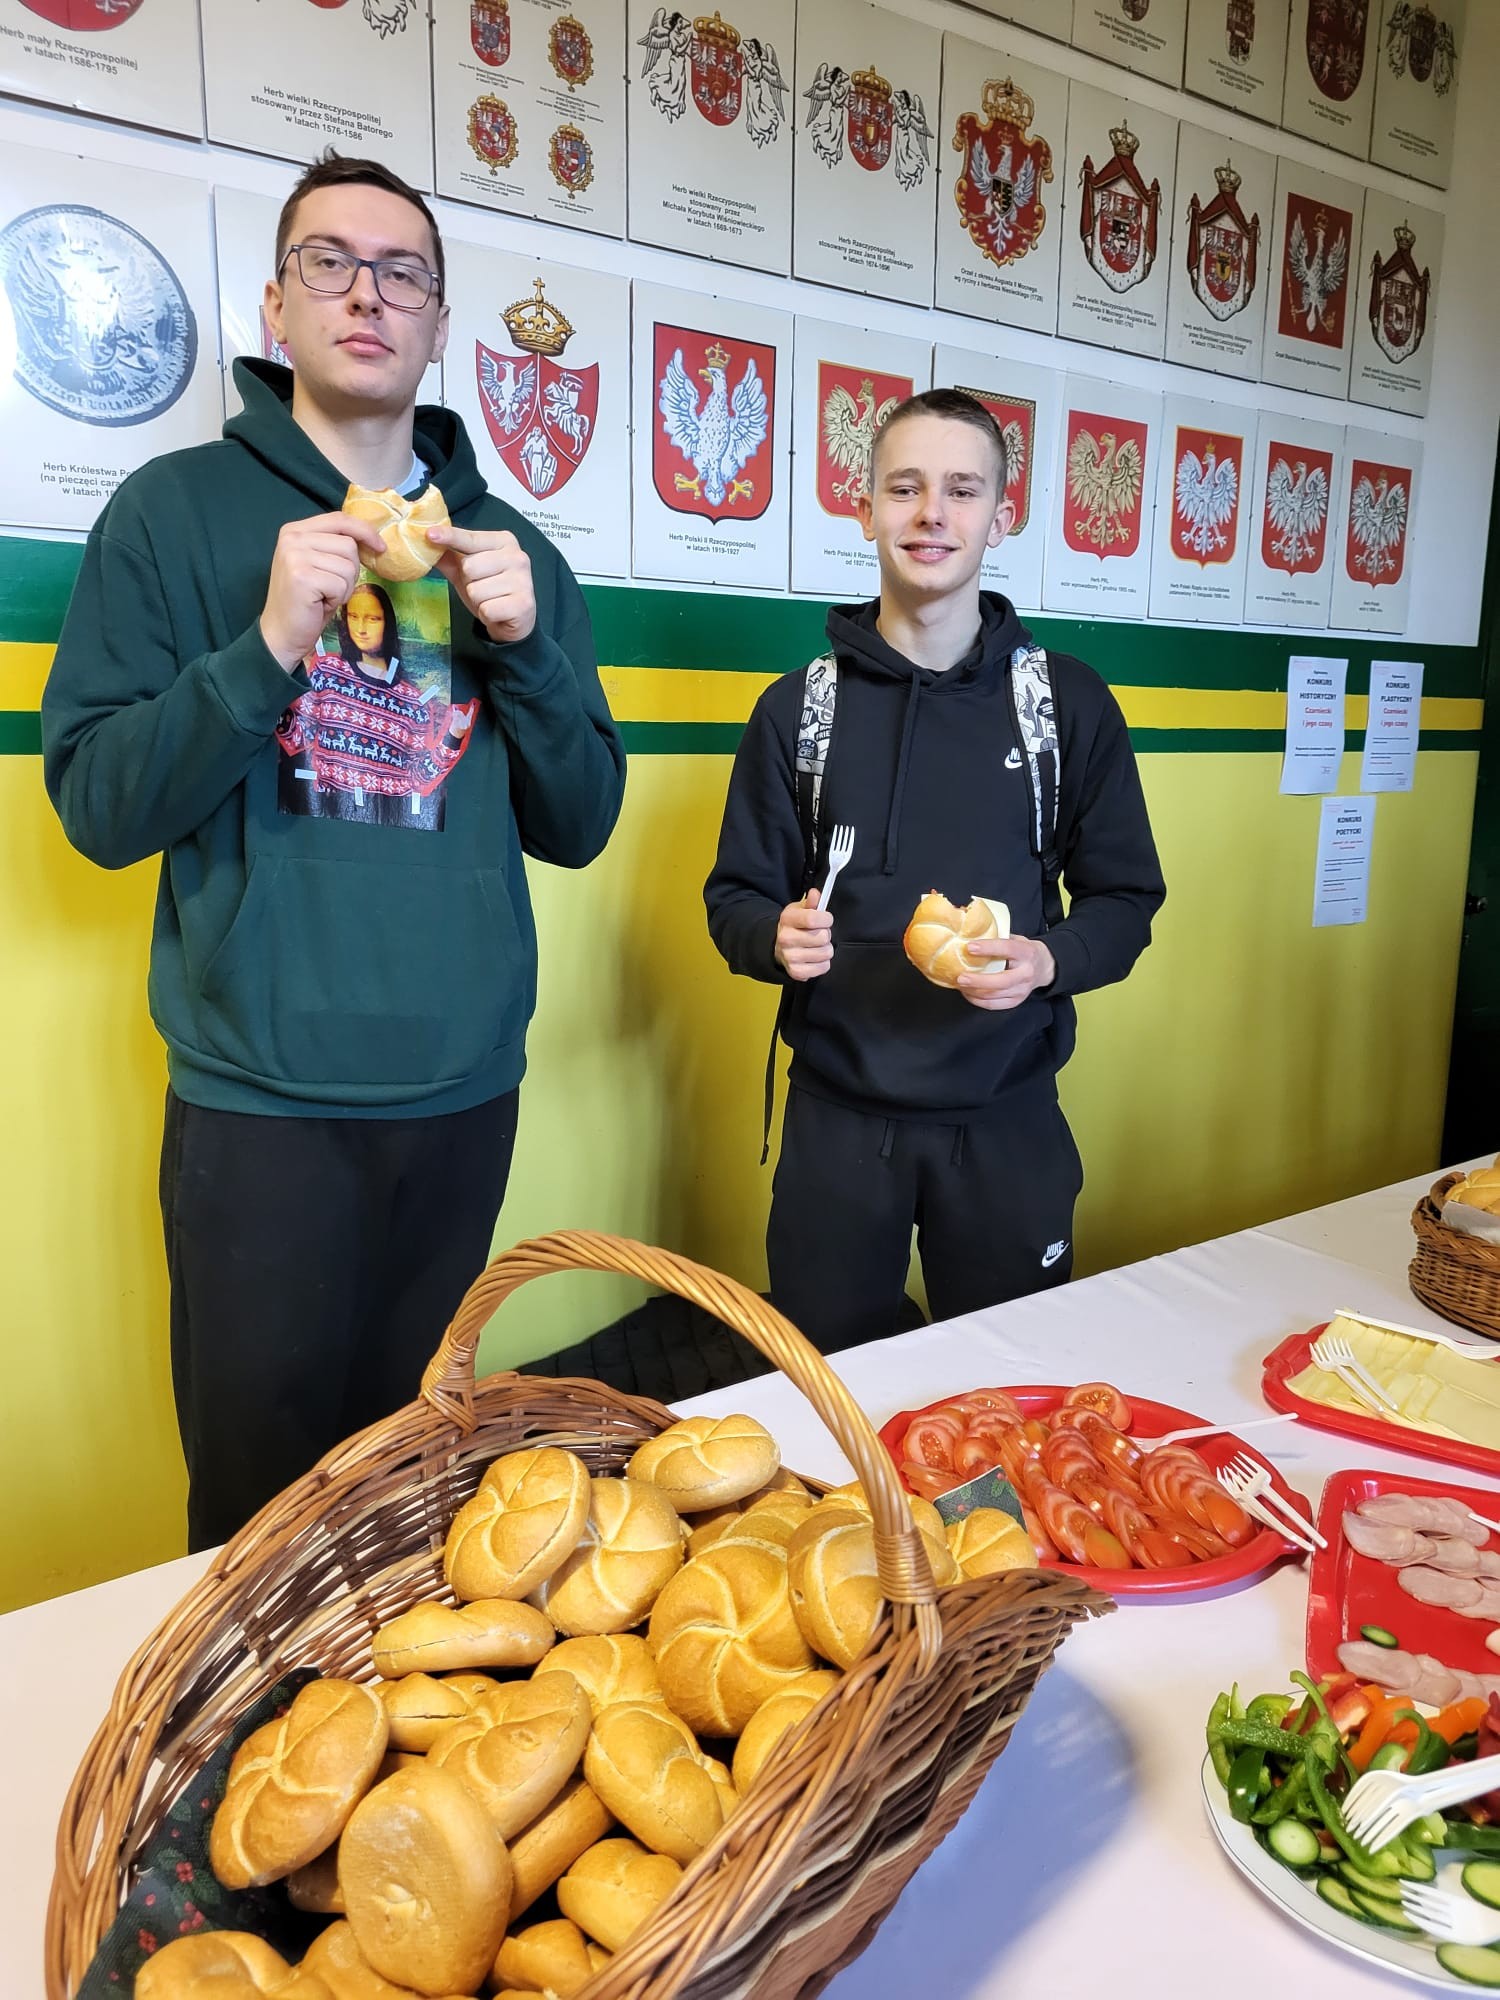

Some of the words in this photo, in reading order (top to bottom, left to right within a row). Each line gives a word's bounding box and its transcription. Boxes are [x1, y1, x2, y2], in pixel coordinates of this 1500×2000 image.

[23, 45, 32, 53] w
[35, 46, 66, 62] latach
[69, 55, 118, 75] 1586-1795
[27, 33, 52, 47] mały
[55, 39, 138, 71] Rzeczypospolitej
[263, 85, 285, 98] Herb
[286, 92, 310, 106] wielki
[312, 99, 382, 126] Rzeczypospolitej
[251, 95, 297, 114] stosowany
[300, 108, 322, 121] przez
[324, 113, 355, 128] Stefana
[357, 121, 393, 138] Batorego
[294, 115, 320, 129] latach
[322, 123, 363, 140] 1576-1586
[672, 183, 687, 194] Herb
[688, 188, 706, 199] wielki
[707, 193, 757, 213] Rzeczypospolitej
[662, 200, 687, 213] Michała
[687, 206, 715, 220] Korybuta
[689, 199, 721, 213] stosowany
[724, 208, 740, 217] przez
[693, 217, 712, 228] latach
[43, 462, 67, 472] Herb
[69, 464, 117, 477] Królestwa
[40, 473, 56, 483] (na
[59, 475, 98, 487] pieczęci
[73, 486, 102, 497] latach
[540, 511, 560, 520] Polski
[550, 522, 595, 534] Styczniowego
[669, 533, 683, 541] Herb
[684, 534, 703, 543] Polski
[708, 538, 757, 550] Rzeczypospolitej
[692, 544, 710, 553] latach
